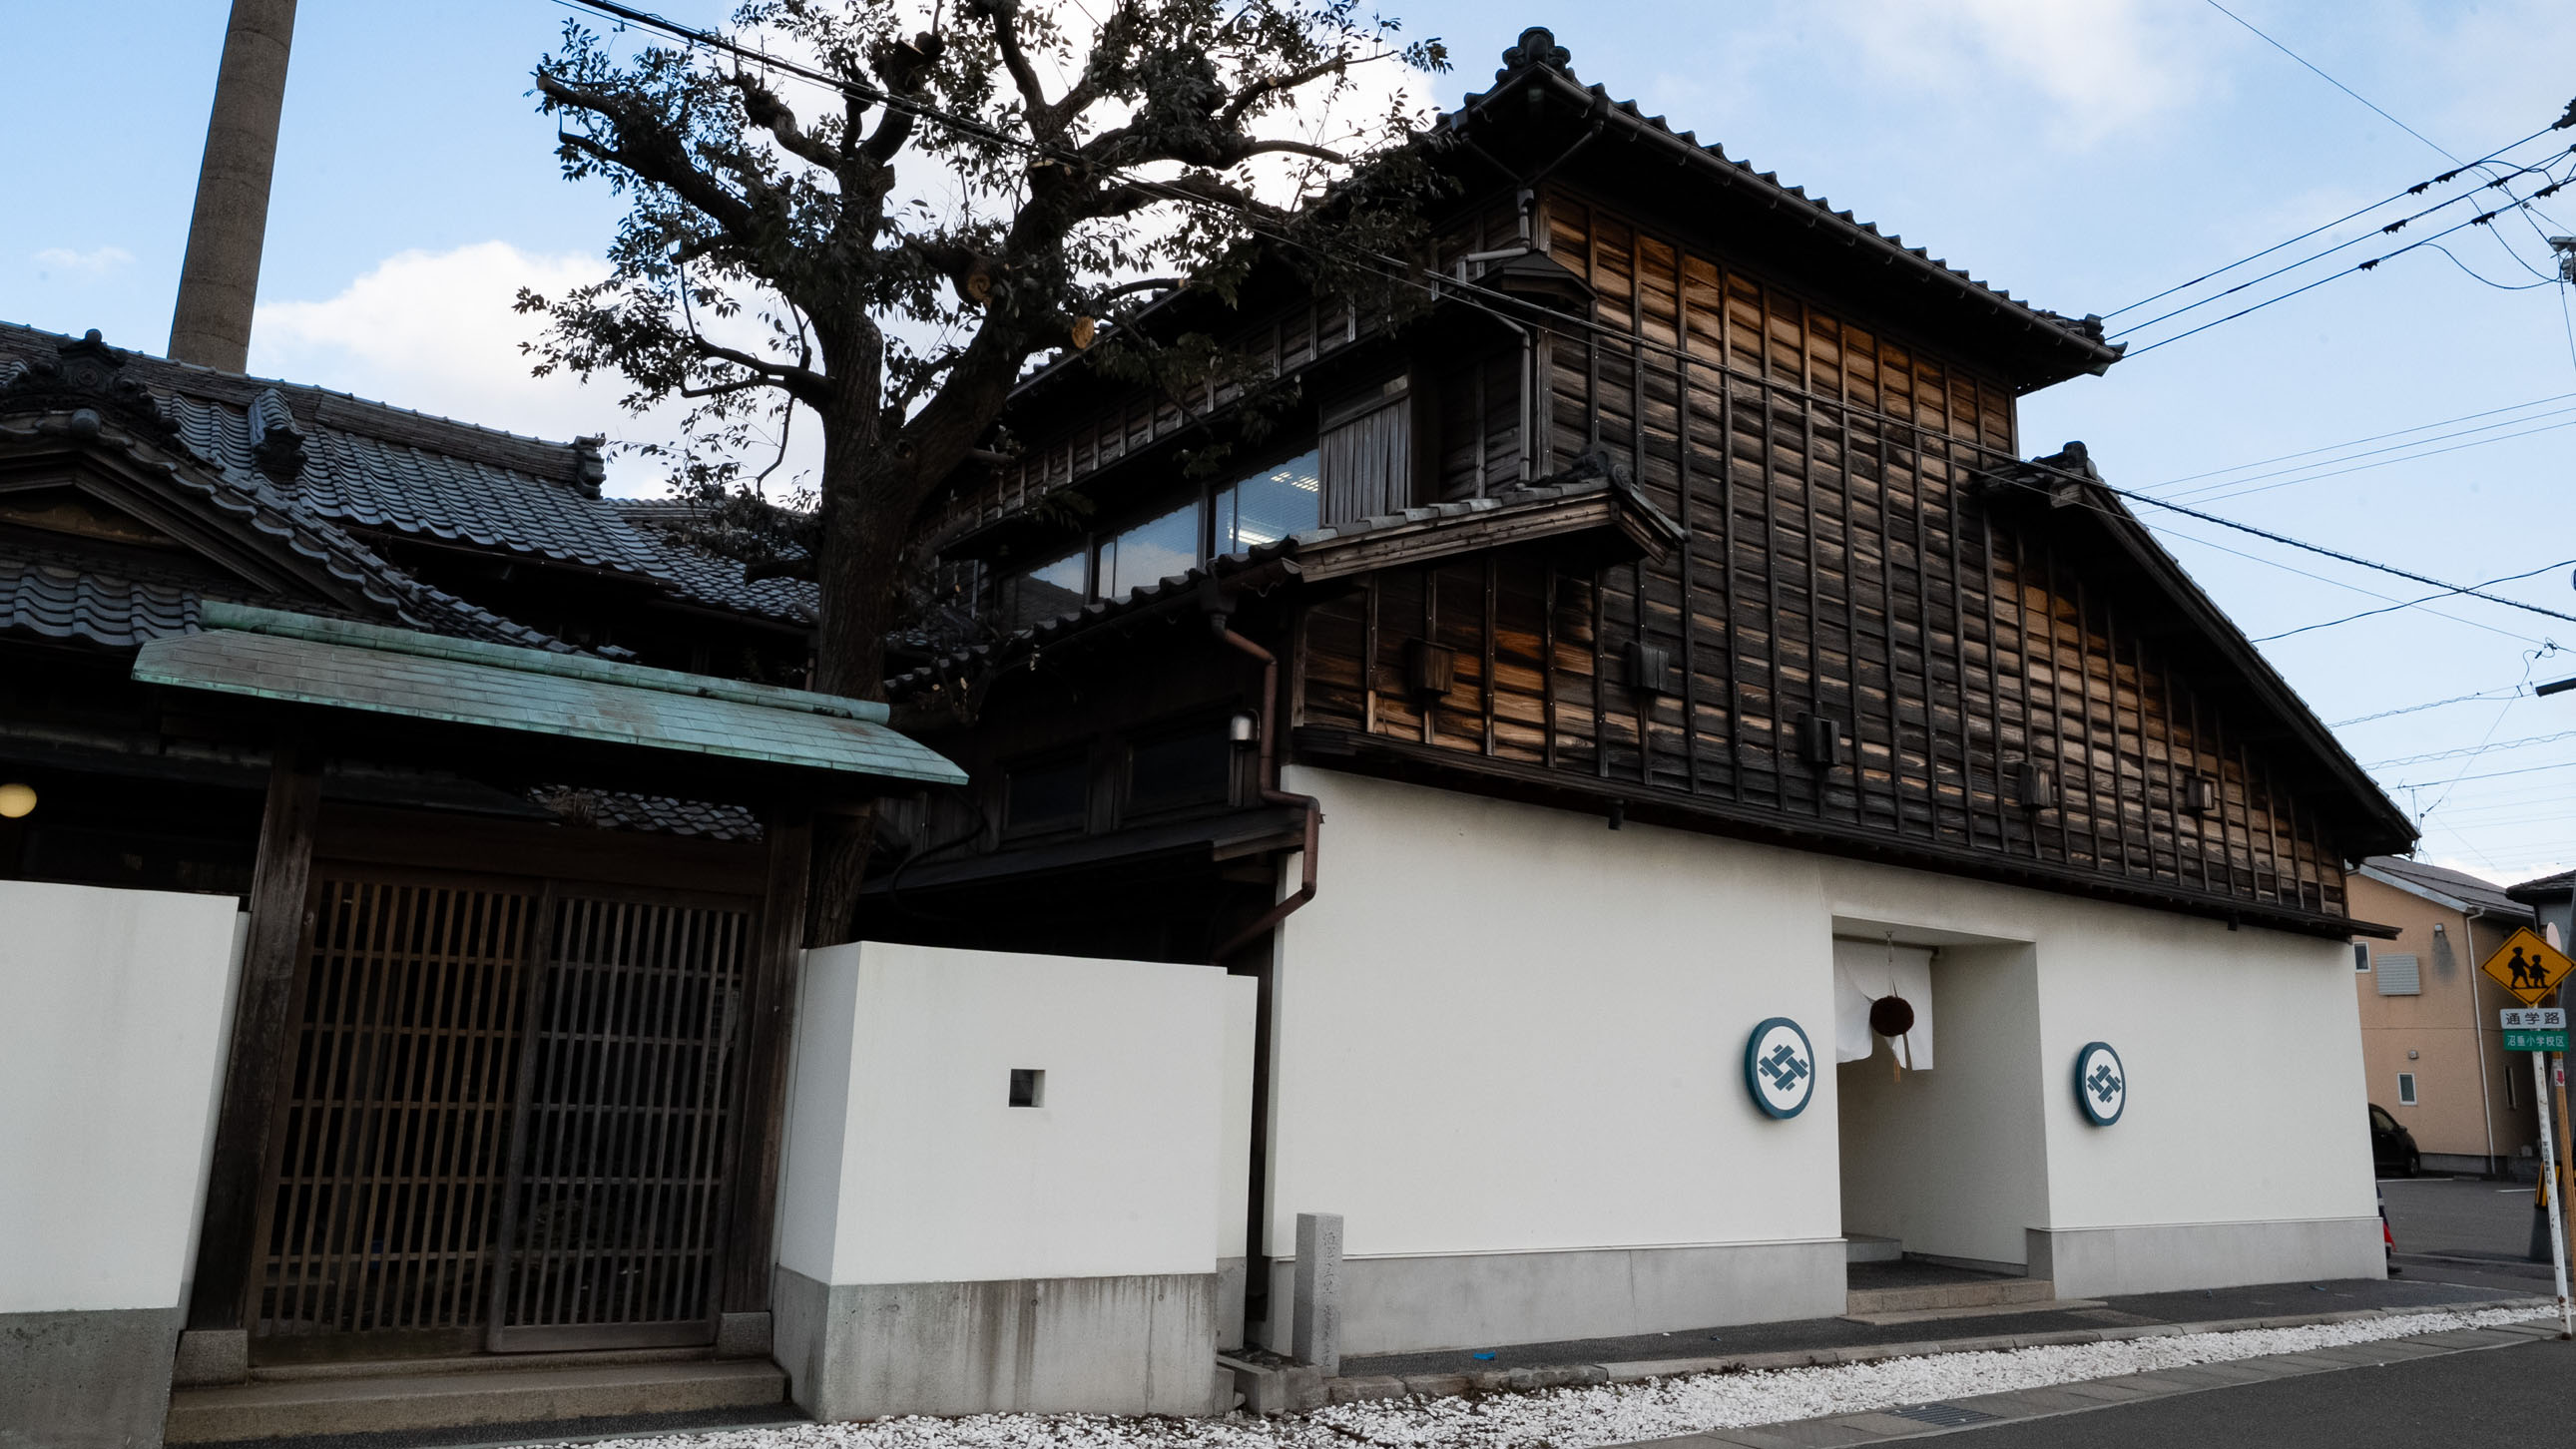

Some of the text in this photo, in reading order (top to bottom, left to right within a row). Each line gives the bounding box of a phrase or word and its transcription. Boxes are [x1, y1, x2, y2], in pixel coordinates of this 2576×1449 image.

[2505, 1012, 2560, 1025] 通学路
[2507, 1035, 2565, 1047] 沼垂小学校区
